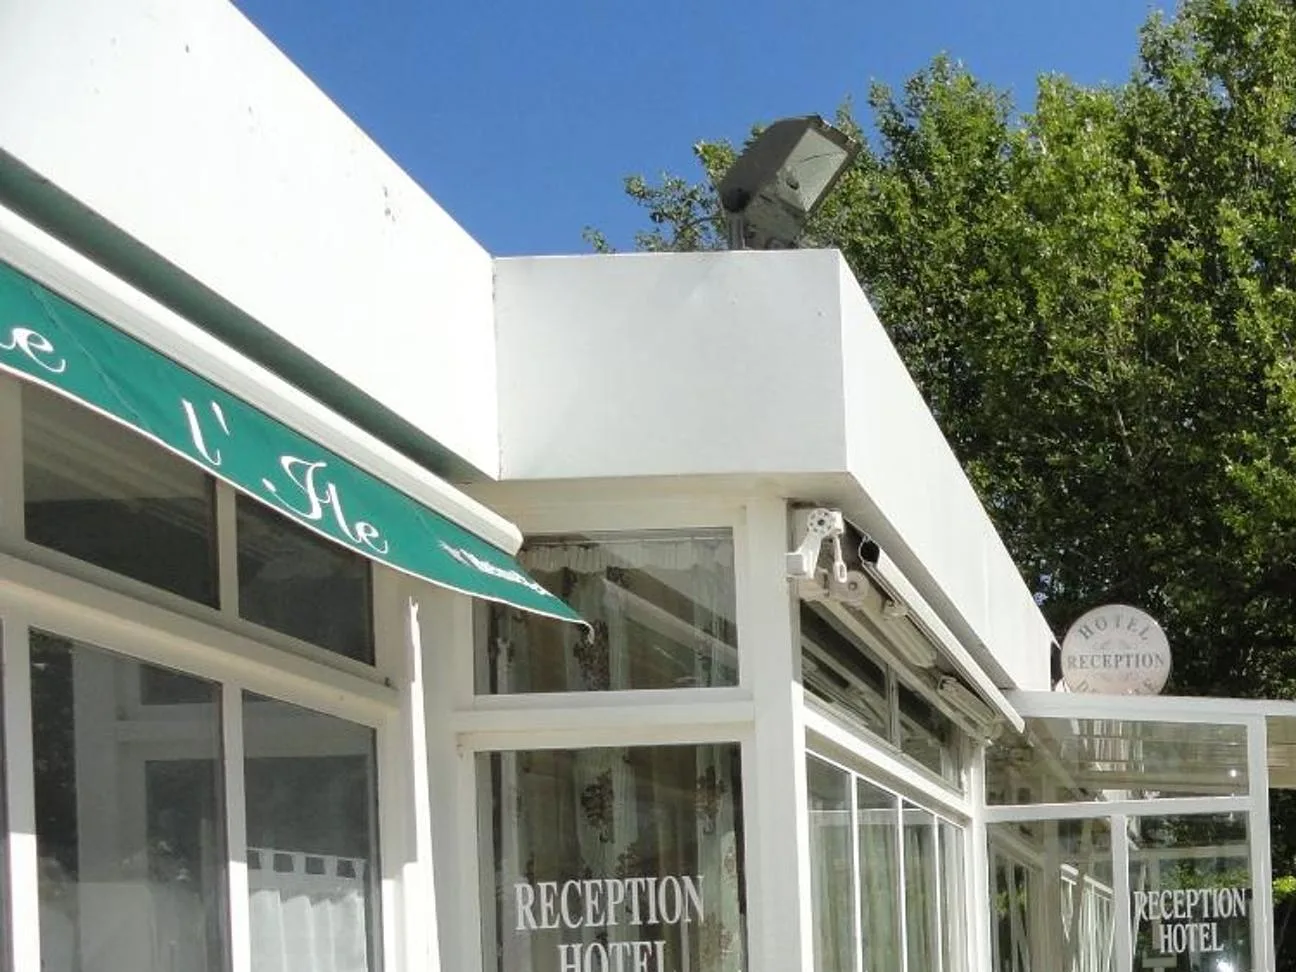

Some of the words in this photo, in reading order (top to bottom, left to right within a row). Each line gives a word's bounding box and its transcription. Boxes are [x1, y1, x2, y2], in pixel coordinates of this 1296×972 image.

[1078, 614, 1151, 641] HOTEL
[1067, 652, 1165, 670] RECEPTION
[514, 875, 705, 931] RECEPTION
[1133, 887, 1247, 921] RECEPTION
[1160, 922, 1224, 954] HOTEL
